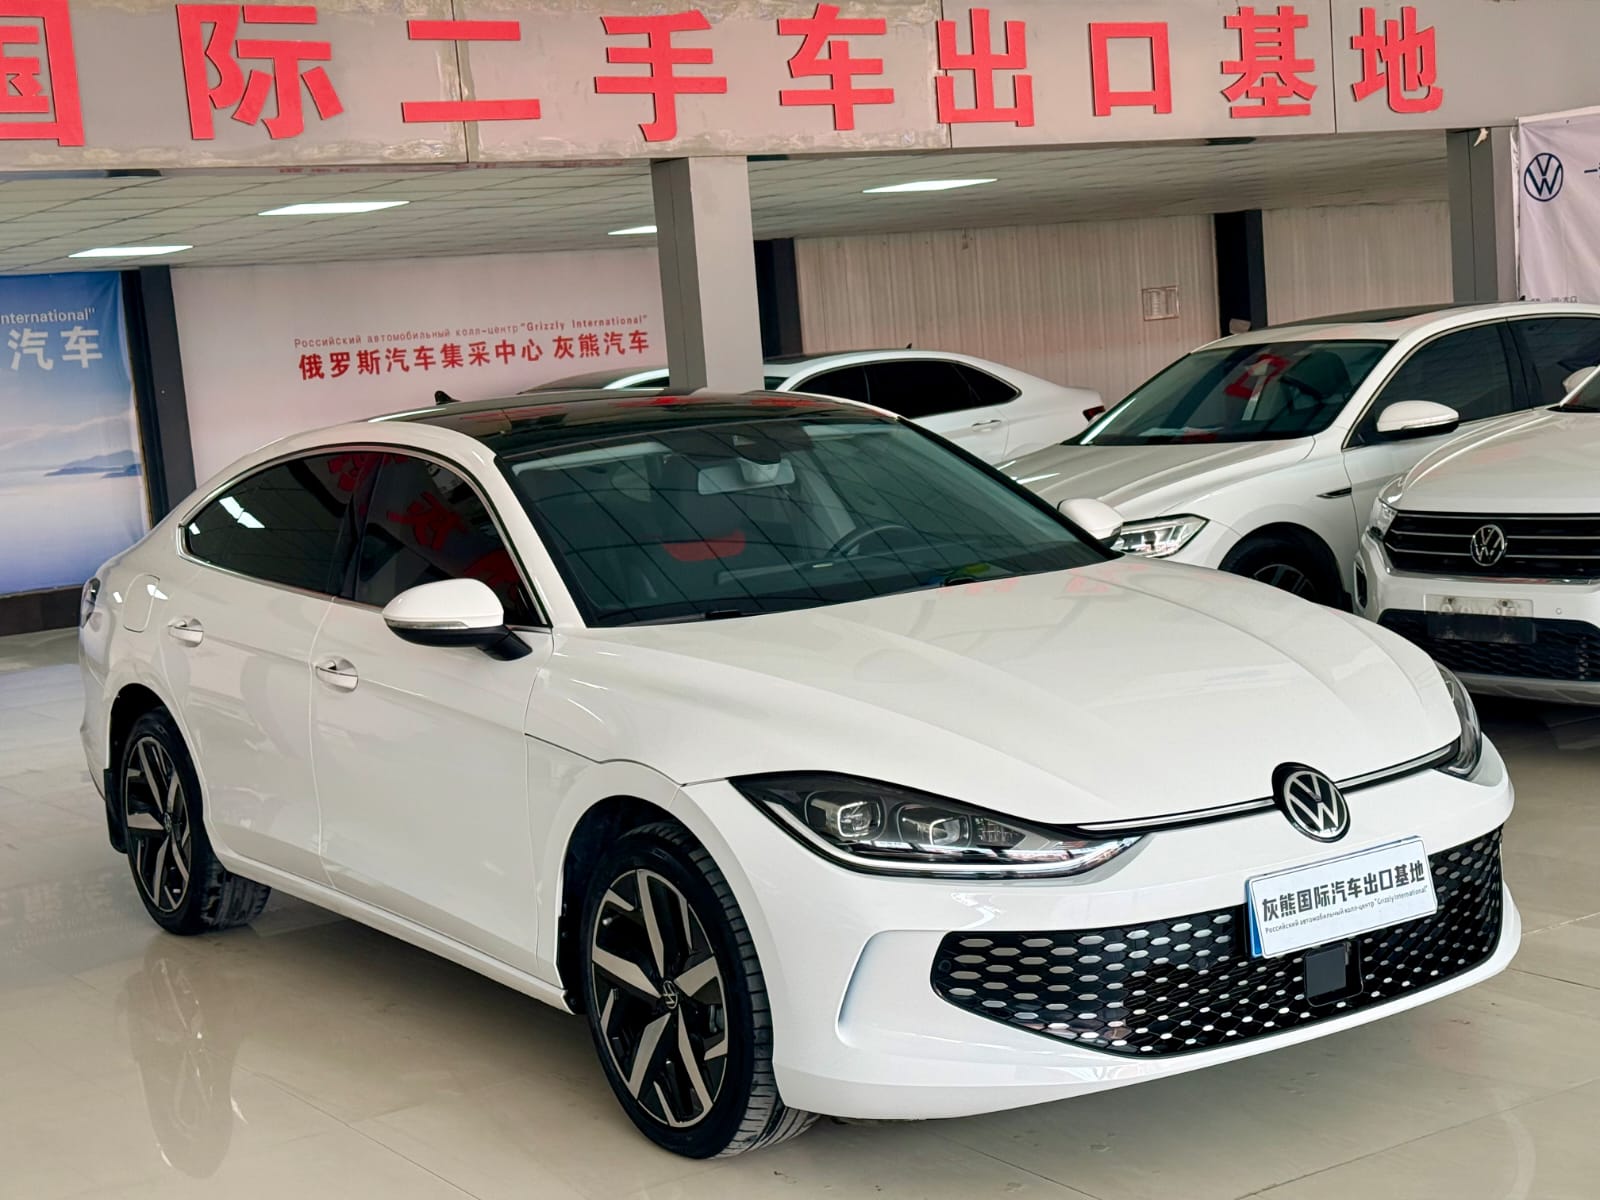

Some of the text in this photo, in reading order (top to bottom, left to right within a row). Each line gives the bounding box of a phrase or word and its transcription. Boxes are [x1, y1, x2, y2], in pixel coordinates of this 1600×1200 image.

[8, 326, 103, 371] 汽车
[294, 335, 362, 349] Российский
[367, 329, 450, 344] автомобильный
[298, 329, 649, 380] 俄罗斯汽车集采中心 灰熊汽车
[1262, 860, 1425, 922] 灰熊国际汽车出口基地
